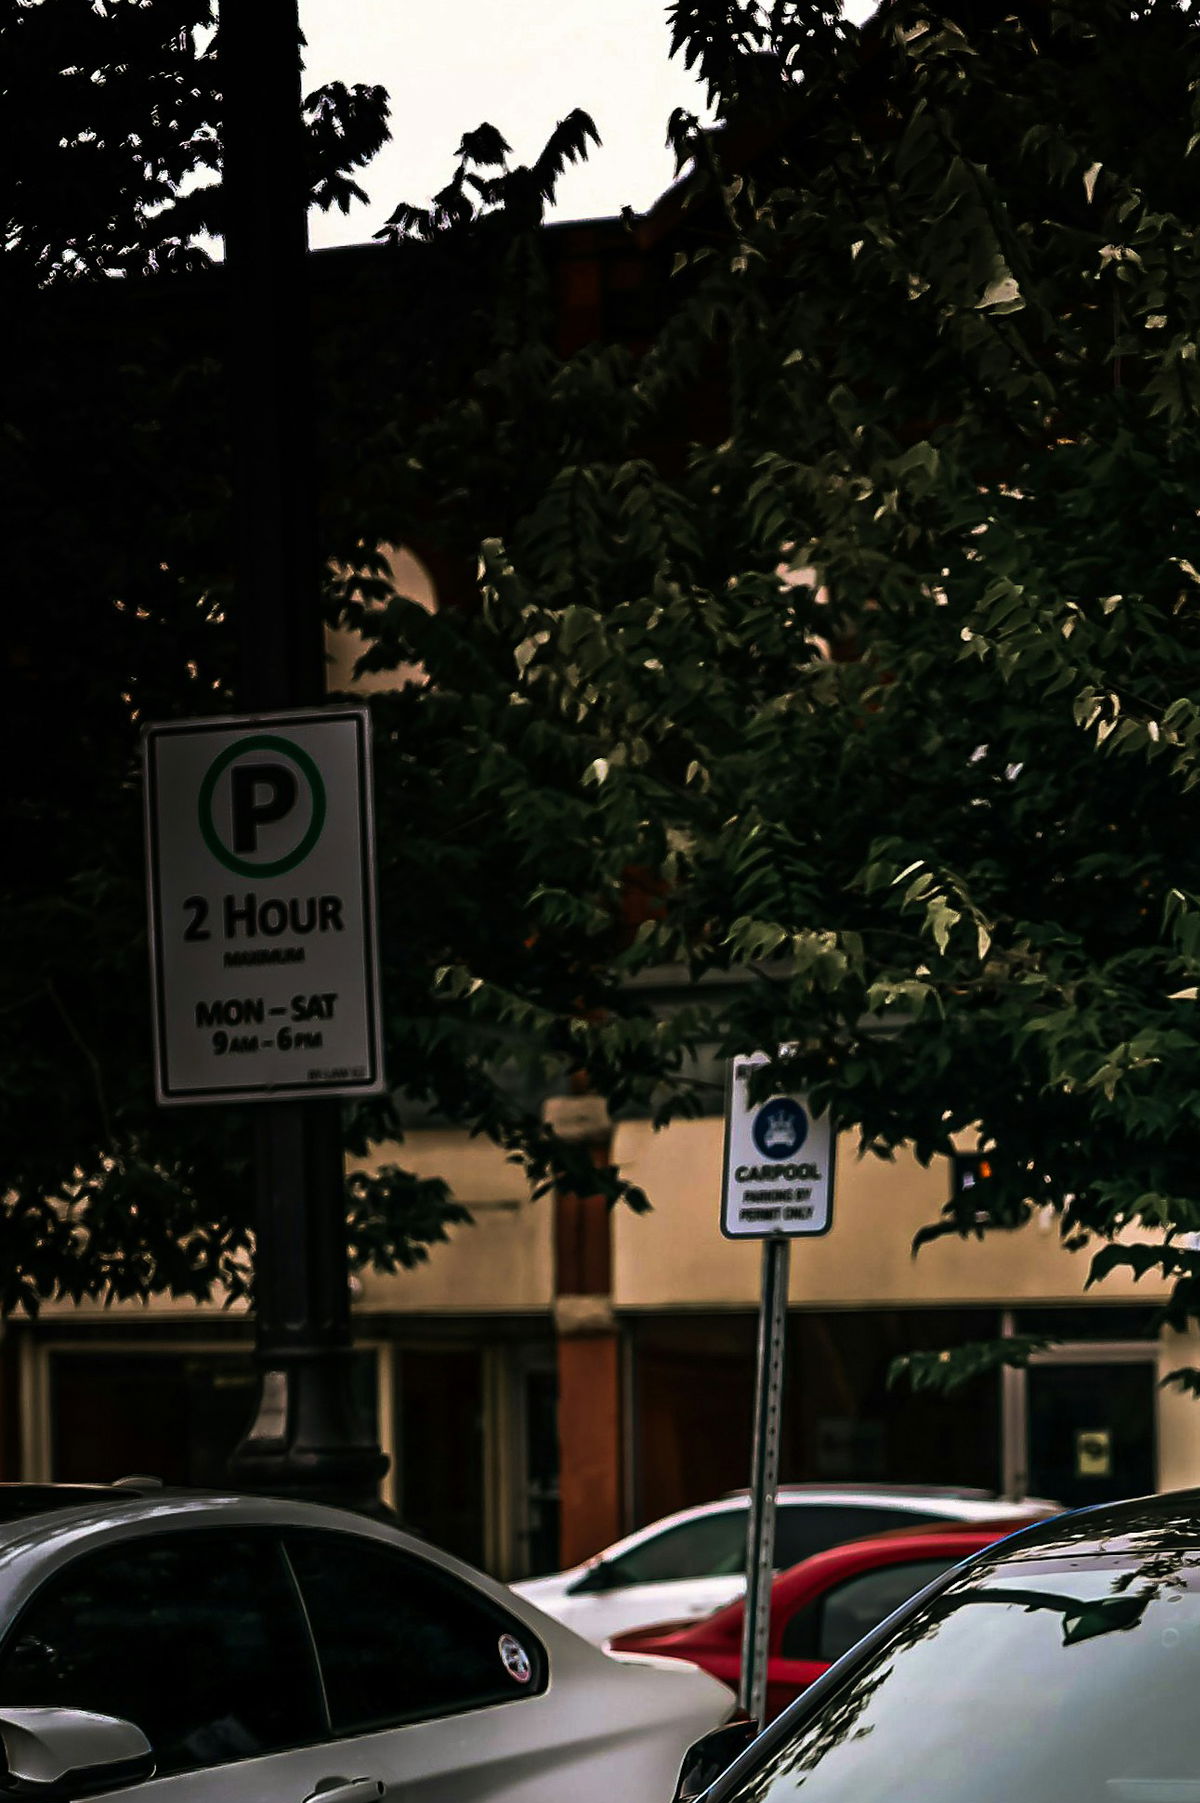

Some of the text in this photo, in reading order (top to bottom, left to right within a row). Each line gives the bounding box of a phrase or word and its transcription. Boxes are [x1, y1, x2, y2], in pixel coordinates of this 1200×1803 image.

[231, 764, 297, 854] P
[184, 893, 344, 941] 2 HOUR
[196, 999, 264, 1027] MON
[292, 993, 338, 1022] SAT
[735, 1163, 822, 1183] CARPOOL
